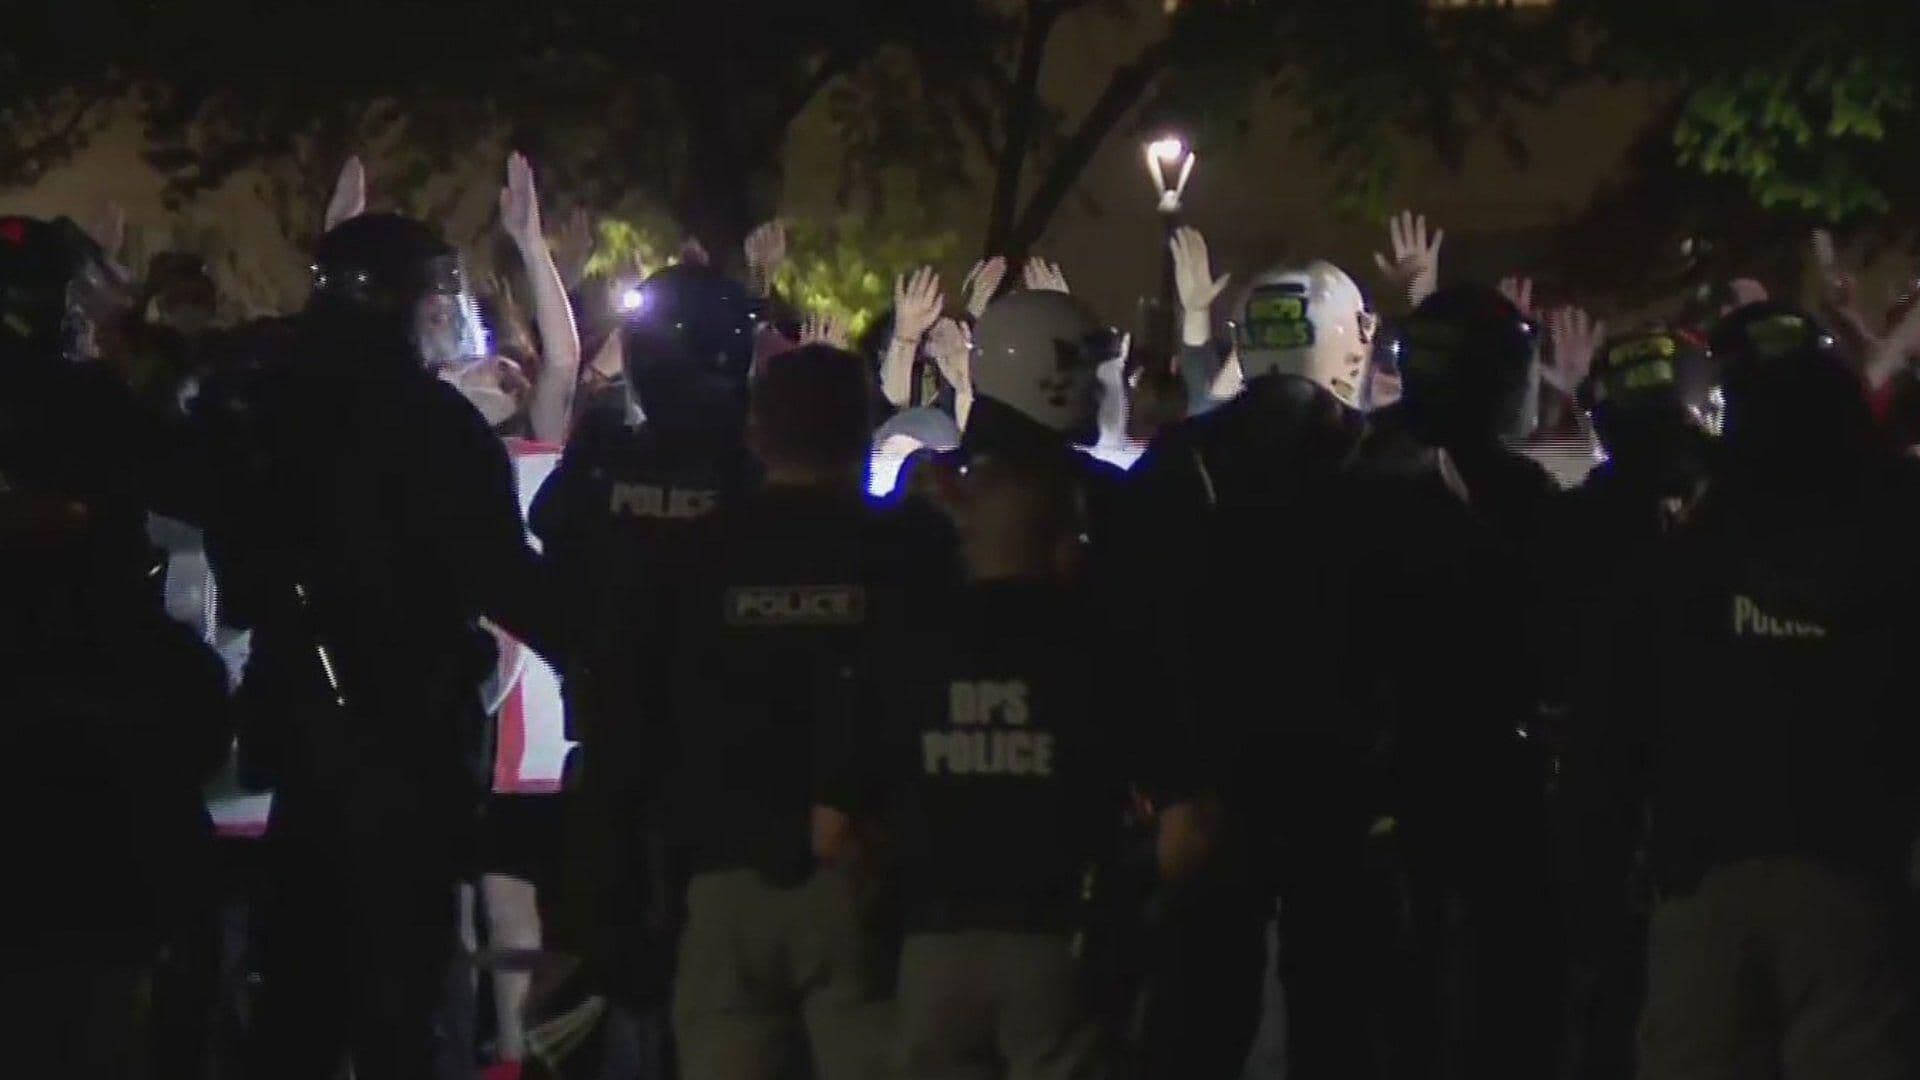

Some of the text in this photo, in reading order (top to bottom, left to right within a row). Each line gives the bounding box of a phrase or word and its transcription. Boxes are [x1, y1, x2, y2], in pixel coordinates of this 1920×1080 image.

[609, 482, 717, 519] POLICE
[736, 591, 859, 617] POLICE
[922, 730, 1055, 776] POLICE
